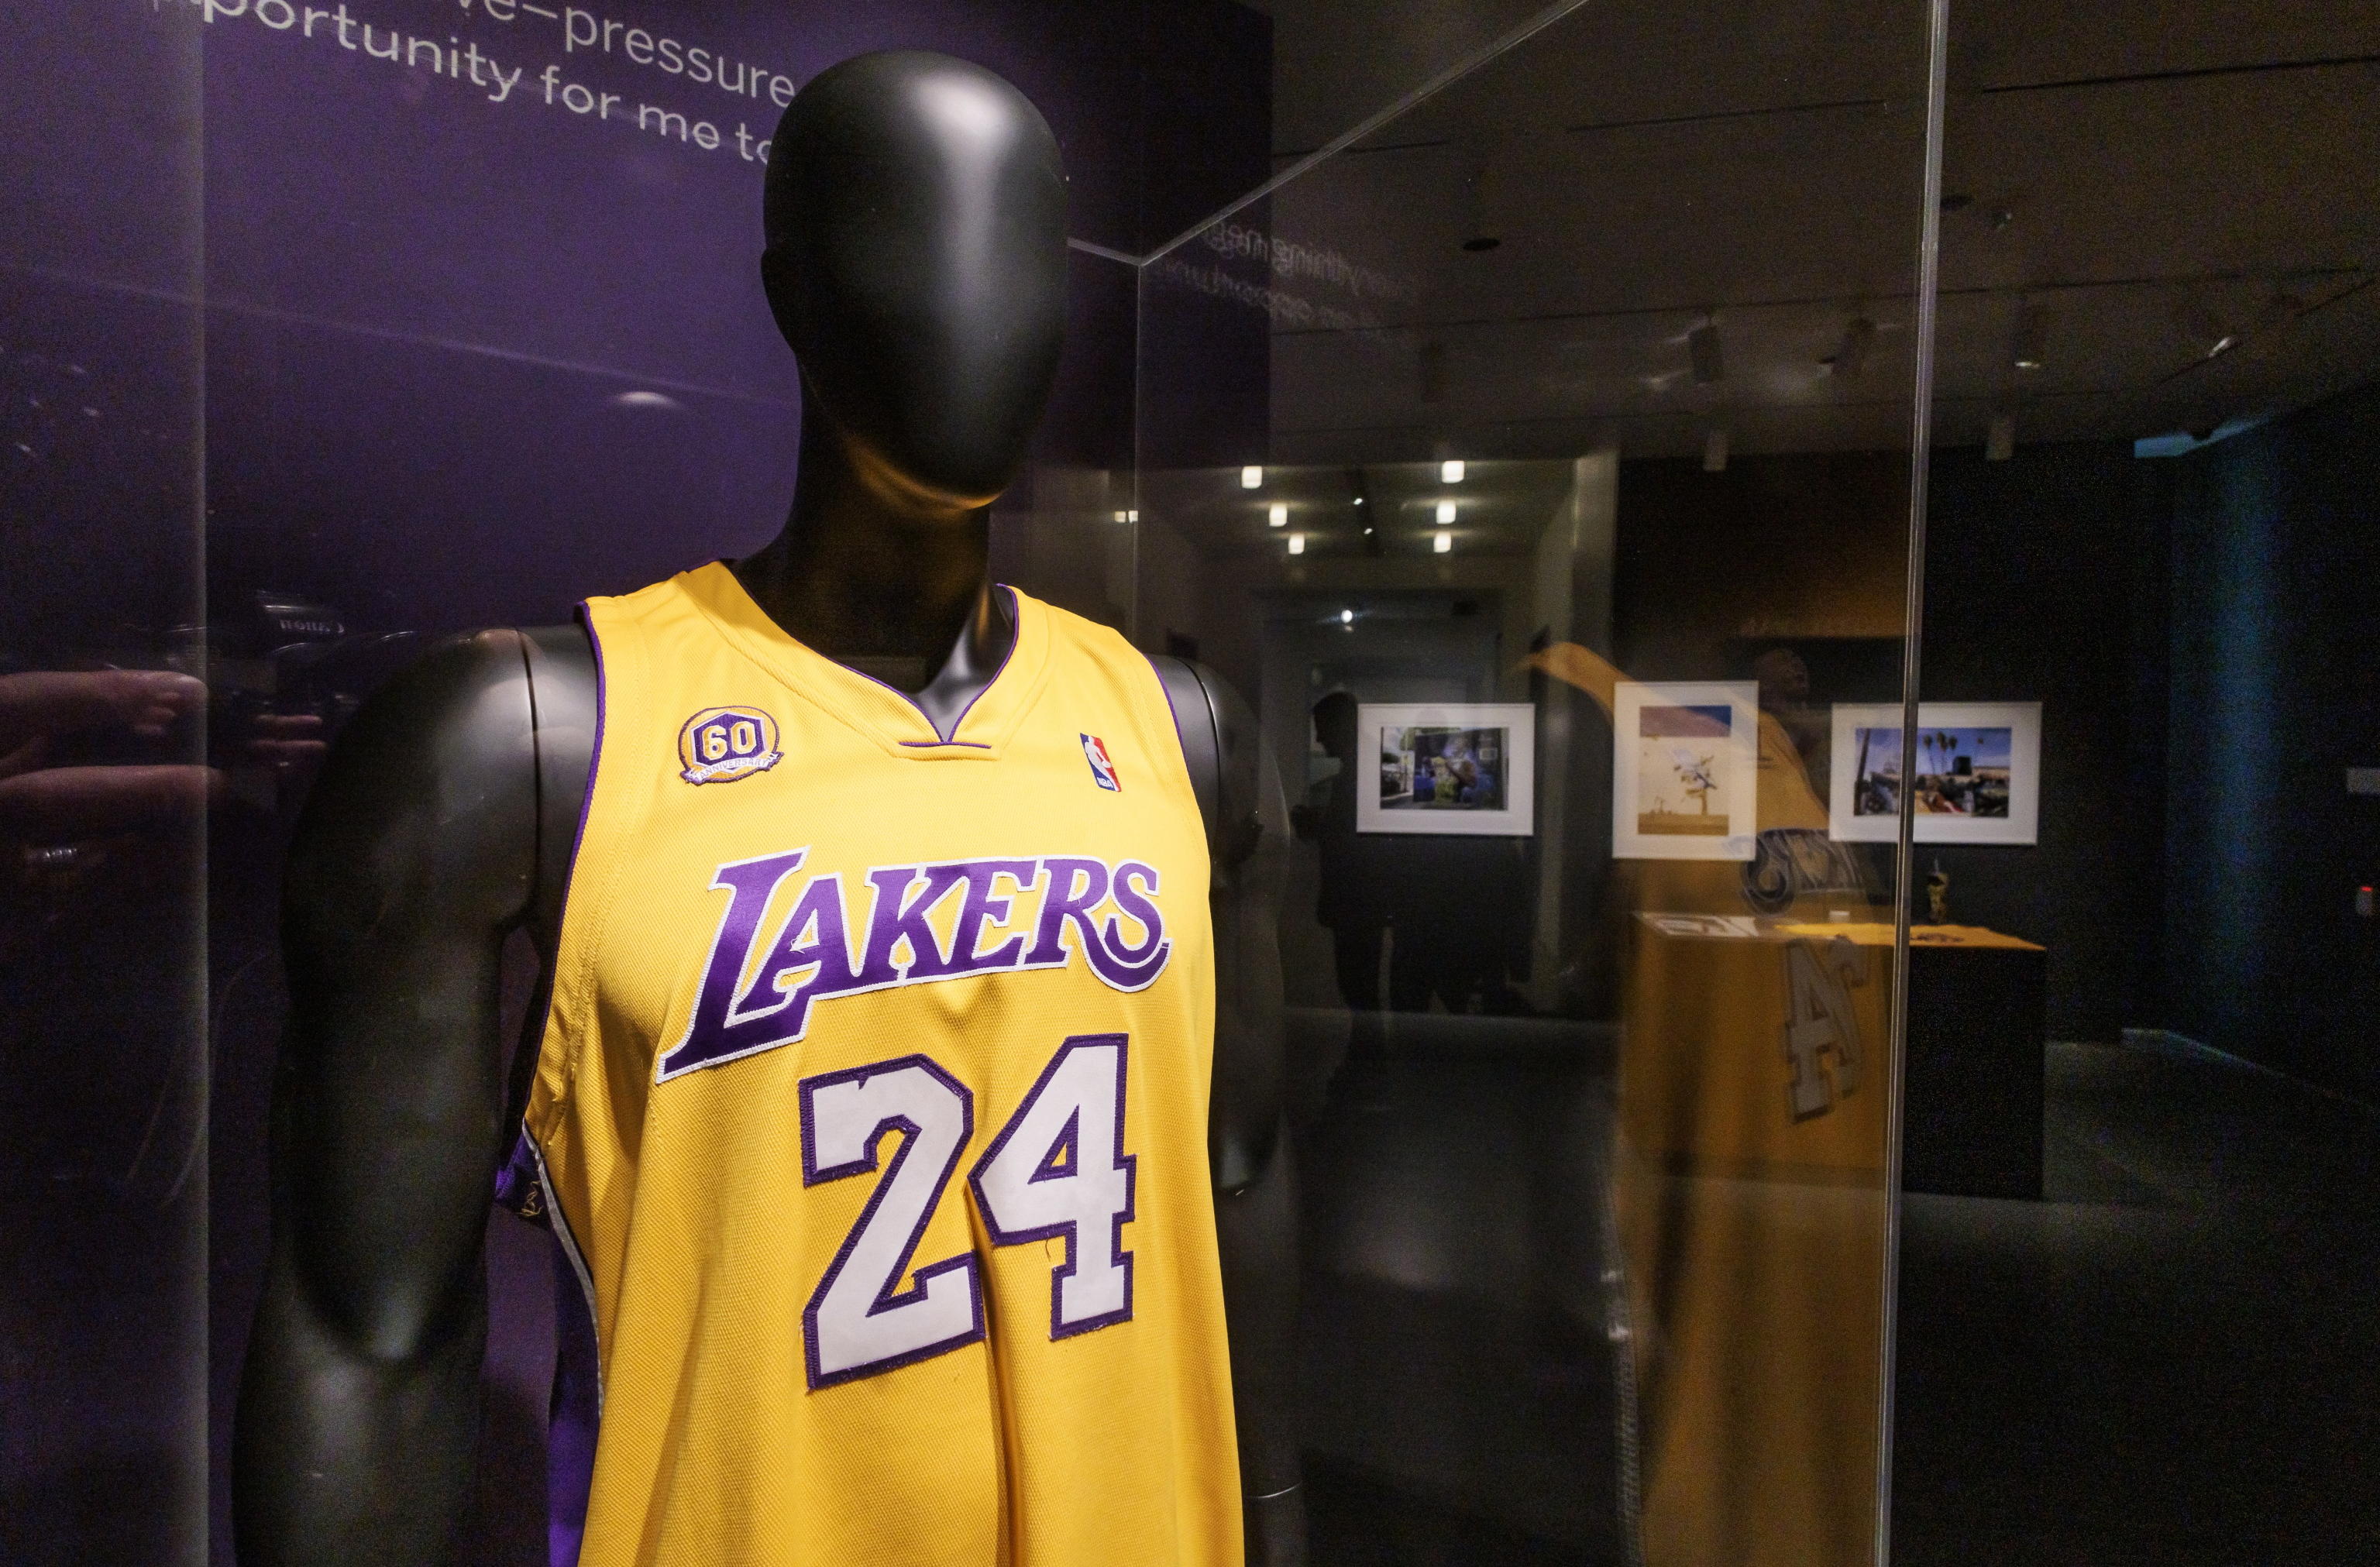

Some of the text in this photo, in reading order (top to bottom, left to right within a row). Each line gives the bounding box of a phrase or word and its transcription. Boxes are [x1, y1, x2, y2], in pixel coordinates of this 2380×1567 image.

[540, 64, 621, 120] for
[638, 102, 721, 149] me
[700, 757, 769, 780] ANNIVERSARY
[701, 720, 758, 761] 60
[655, 845, 1174, 1084] LAKERS
[798, 1033, 1137, 1393] 24
